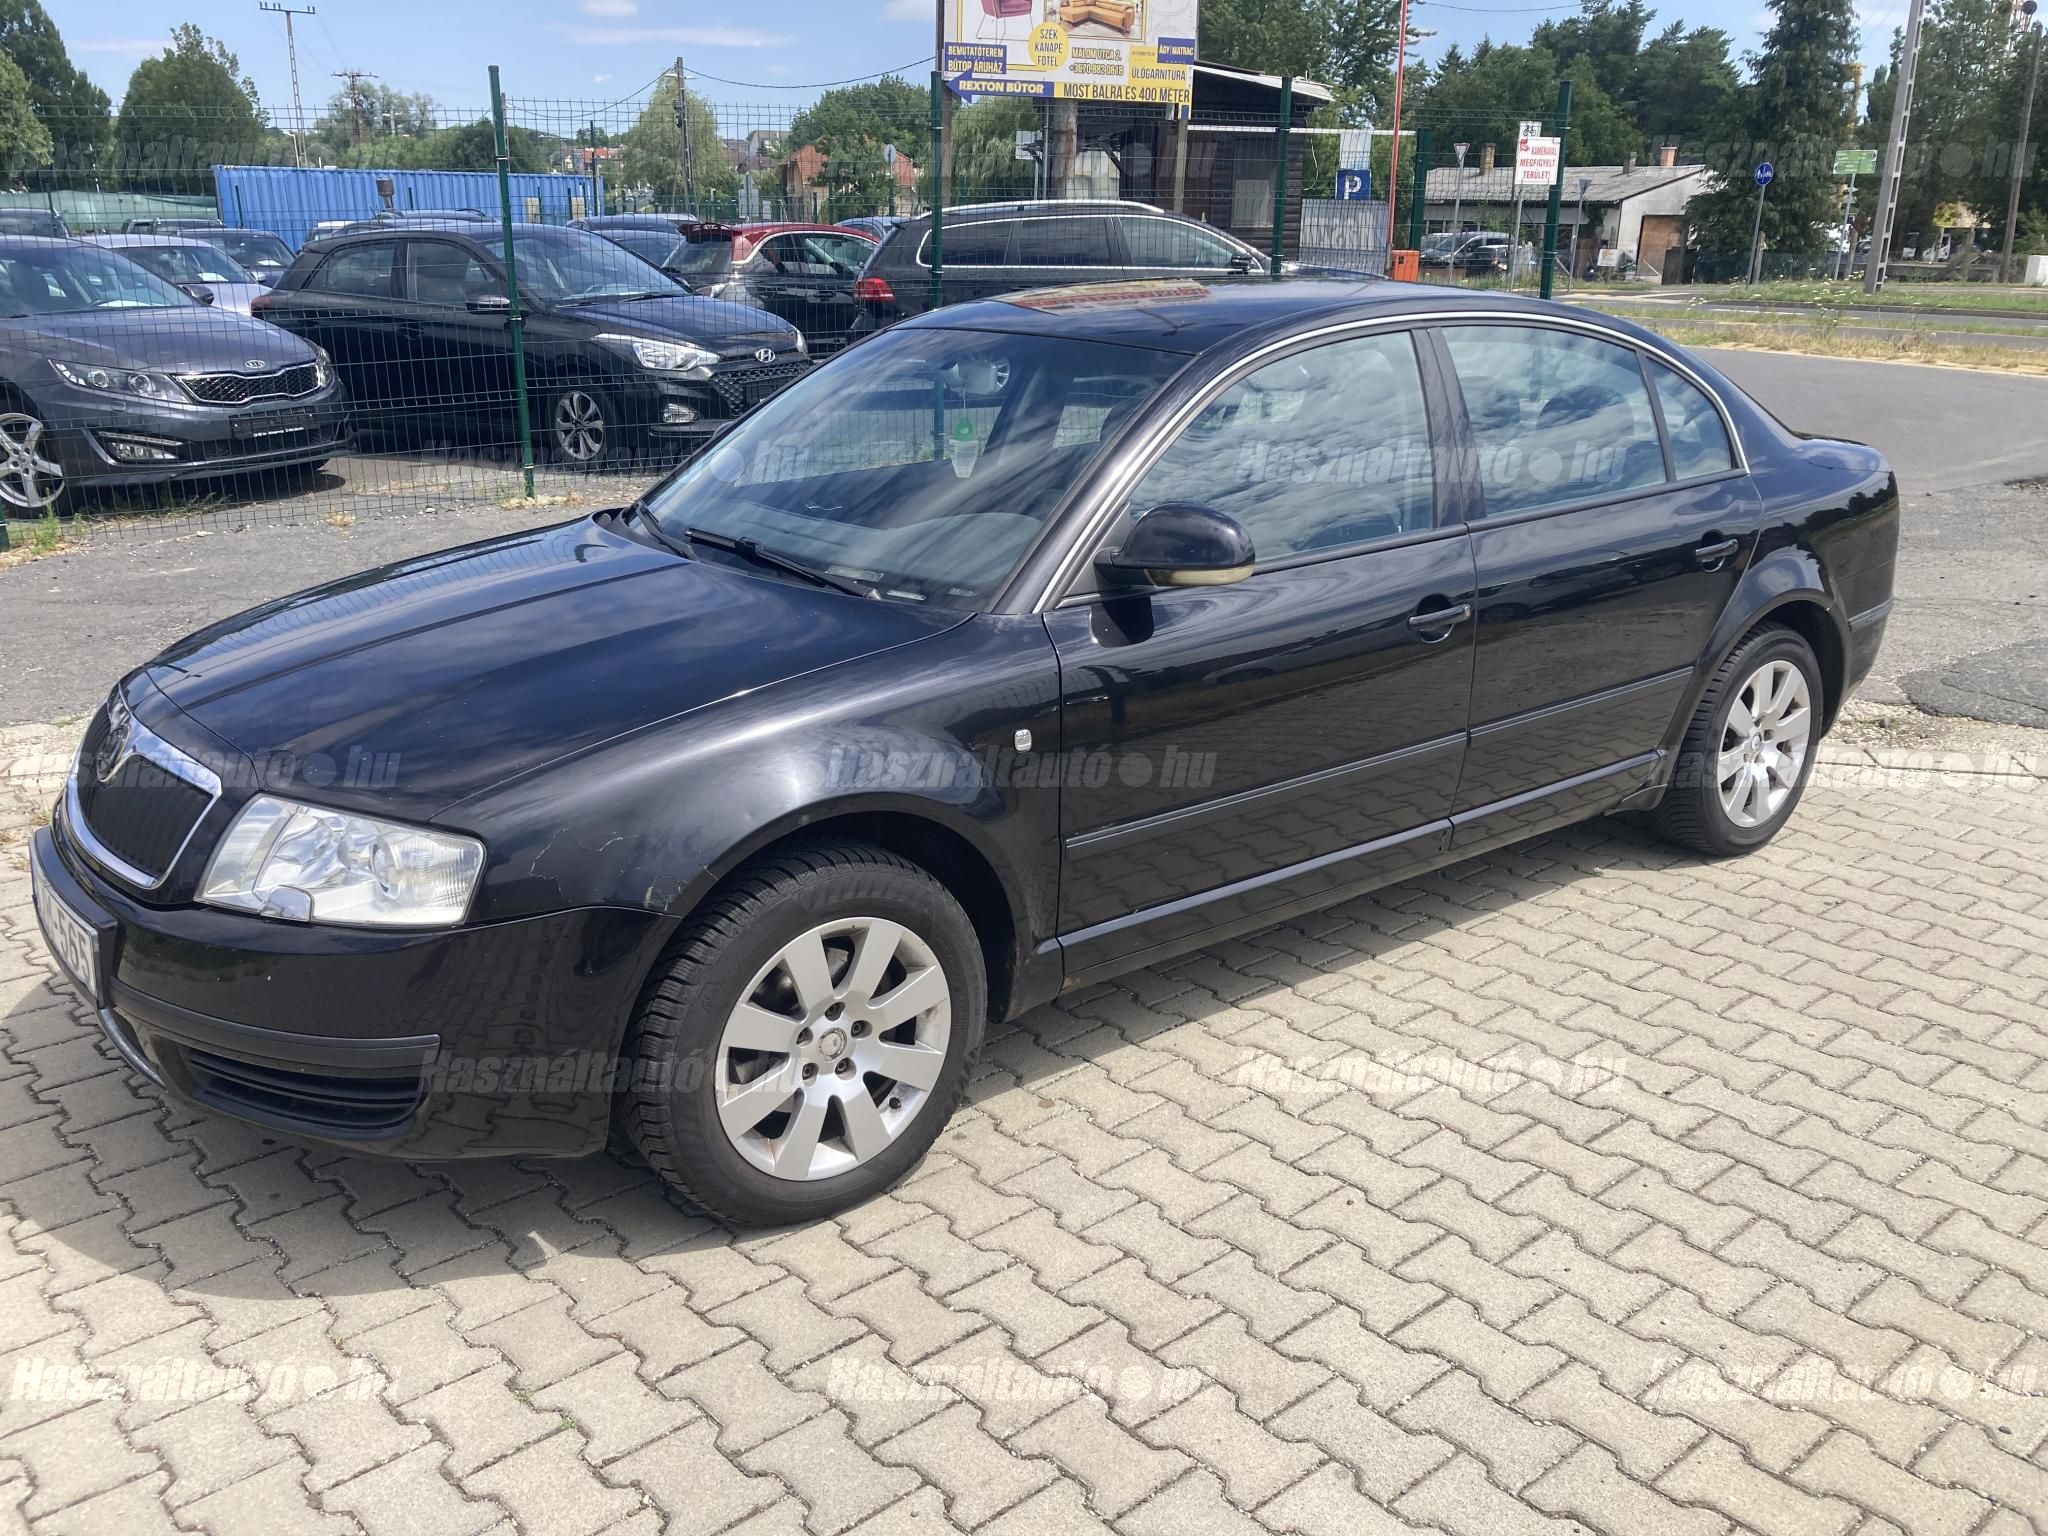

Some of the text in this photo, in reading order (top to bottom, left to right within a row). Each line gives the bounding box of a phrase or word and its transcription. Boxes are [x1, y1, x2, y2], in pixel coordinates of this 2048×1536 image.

[1071, 46, 1096, 59] MALOM
[959, 80, 1044, 94] REXTON BÚTOR
[1063, 83, 1089, 97] MOST
[1092, 84, 1122, 99] BALRA
[1138, 87, 1157, 101] 400
[1519, 158, 1556, 168] MEGFIGYELT
